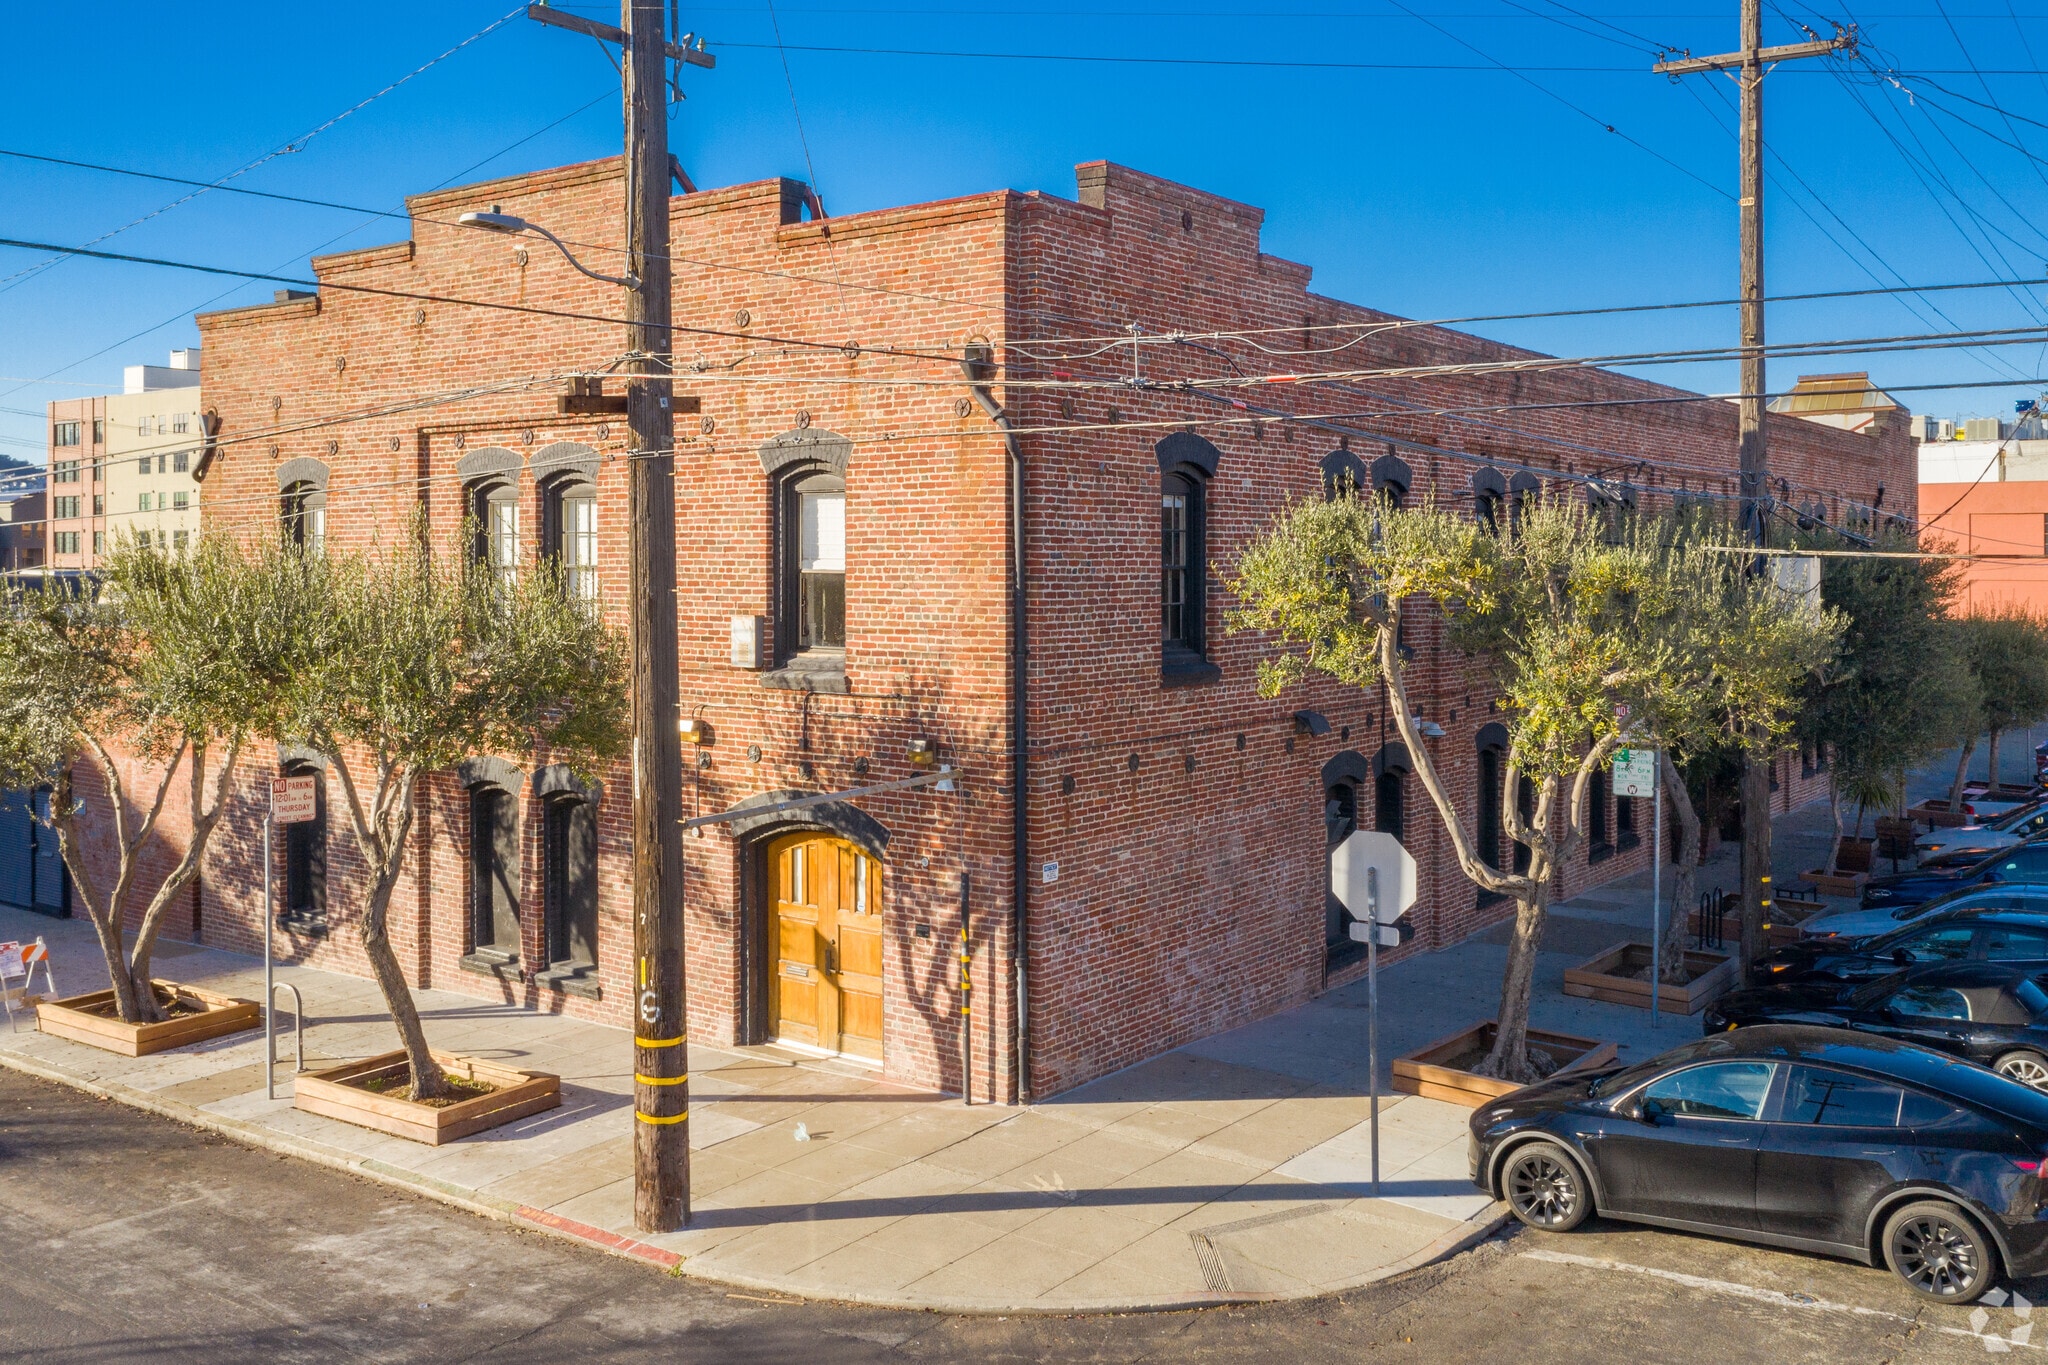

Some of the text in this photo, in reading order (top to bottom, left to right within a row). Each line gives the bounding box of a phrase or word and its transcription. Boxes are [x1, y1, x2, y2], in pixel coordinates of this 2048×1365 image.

[1616, 706, 1626, 716] NO
[274, 780, 313, 792] NO PARKING
[278, 804, 310, 812] THURSDAY
